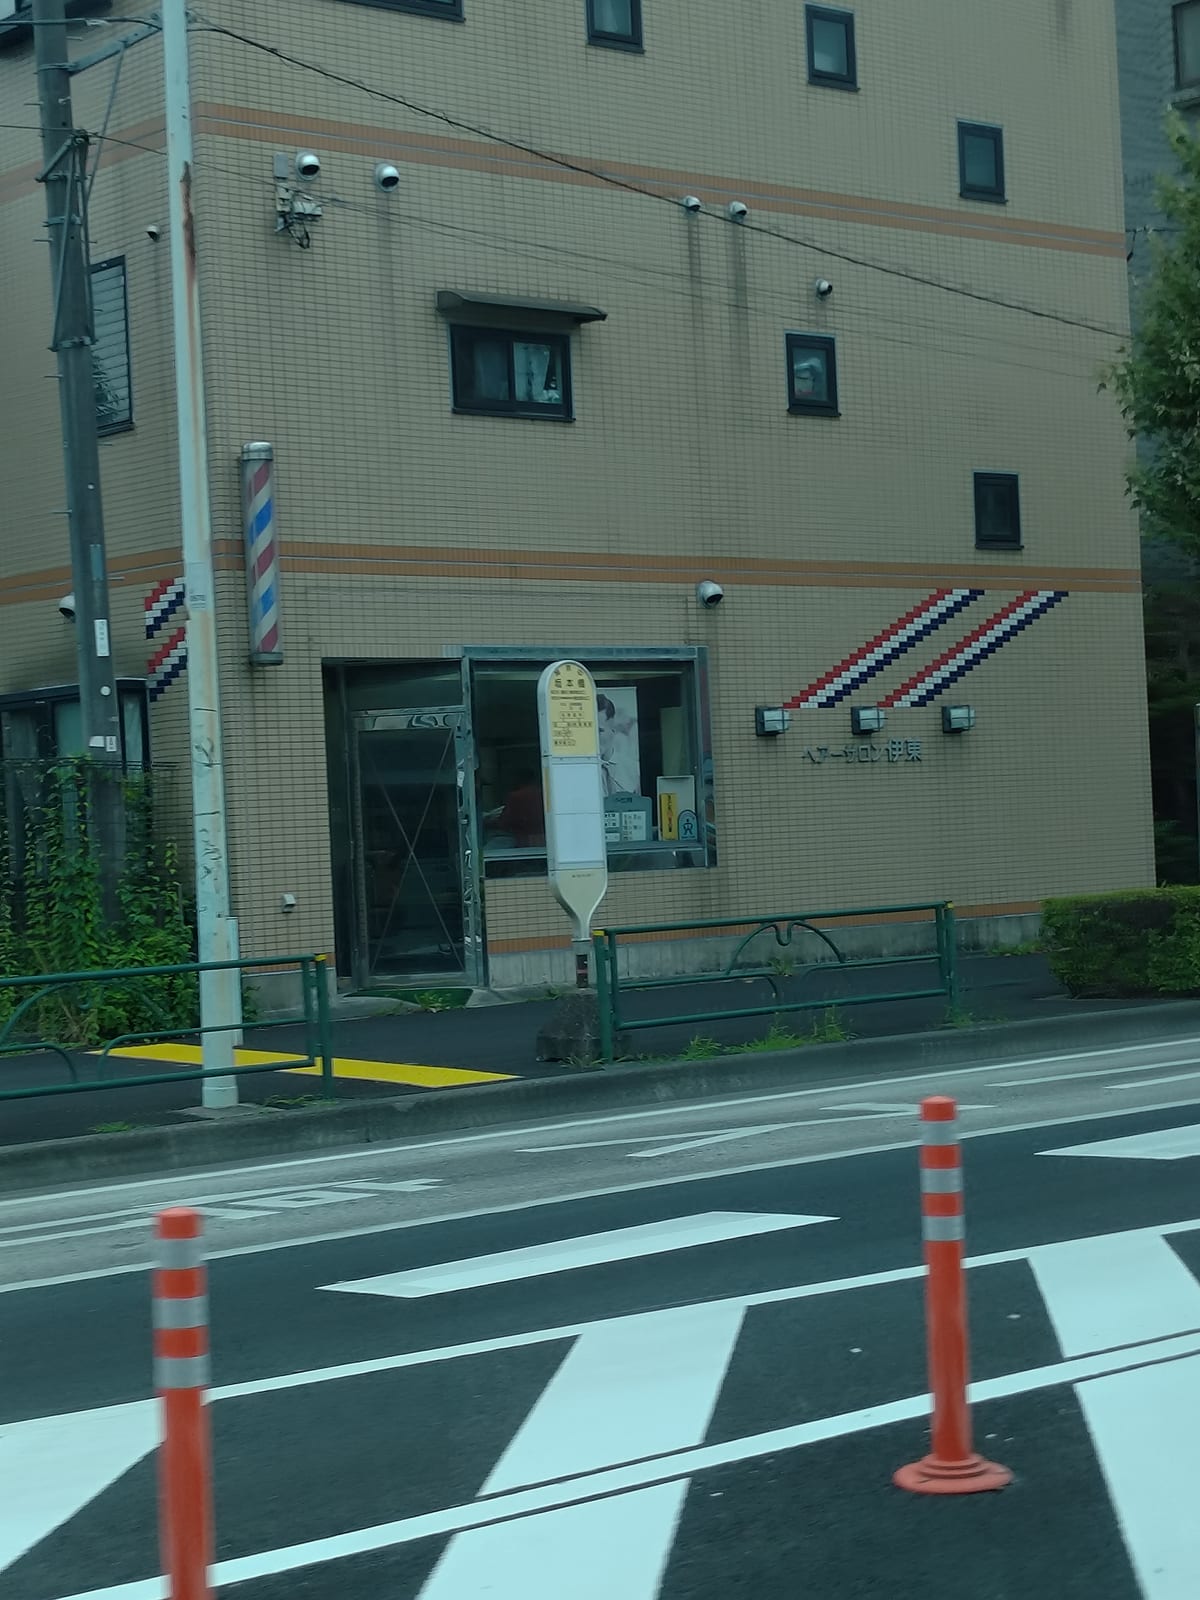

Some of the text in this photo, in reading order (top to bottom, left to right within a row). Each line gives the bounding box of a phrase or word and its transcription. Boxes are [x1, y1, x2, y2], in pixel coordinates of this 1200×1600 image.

[801, 737, 922, 764] ヘアーサロン伊東
